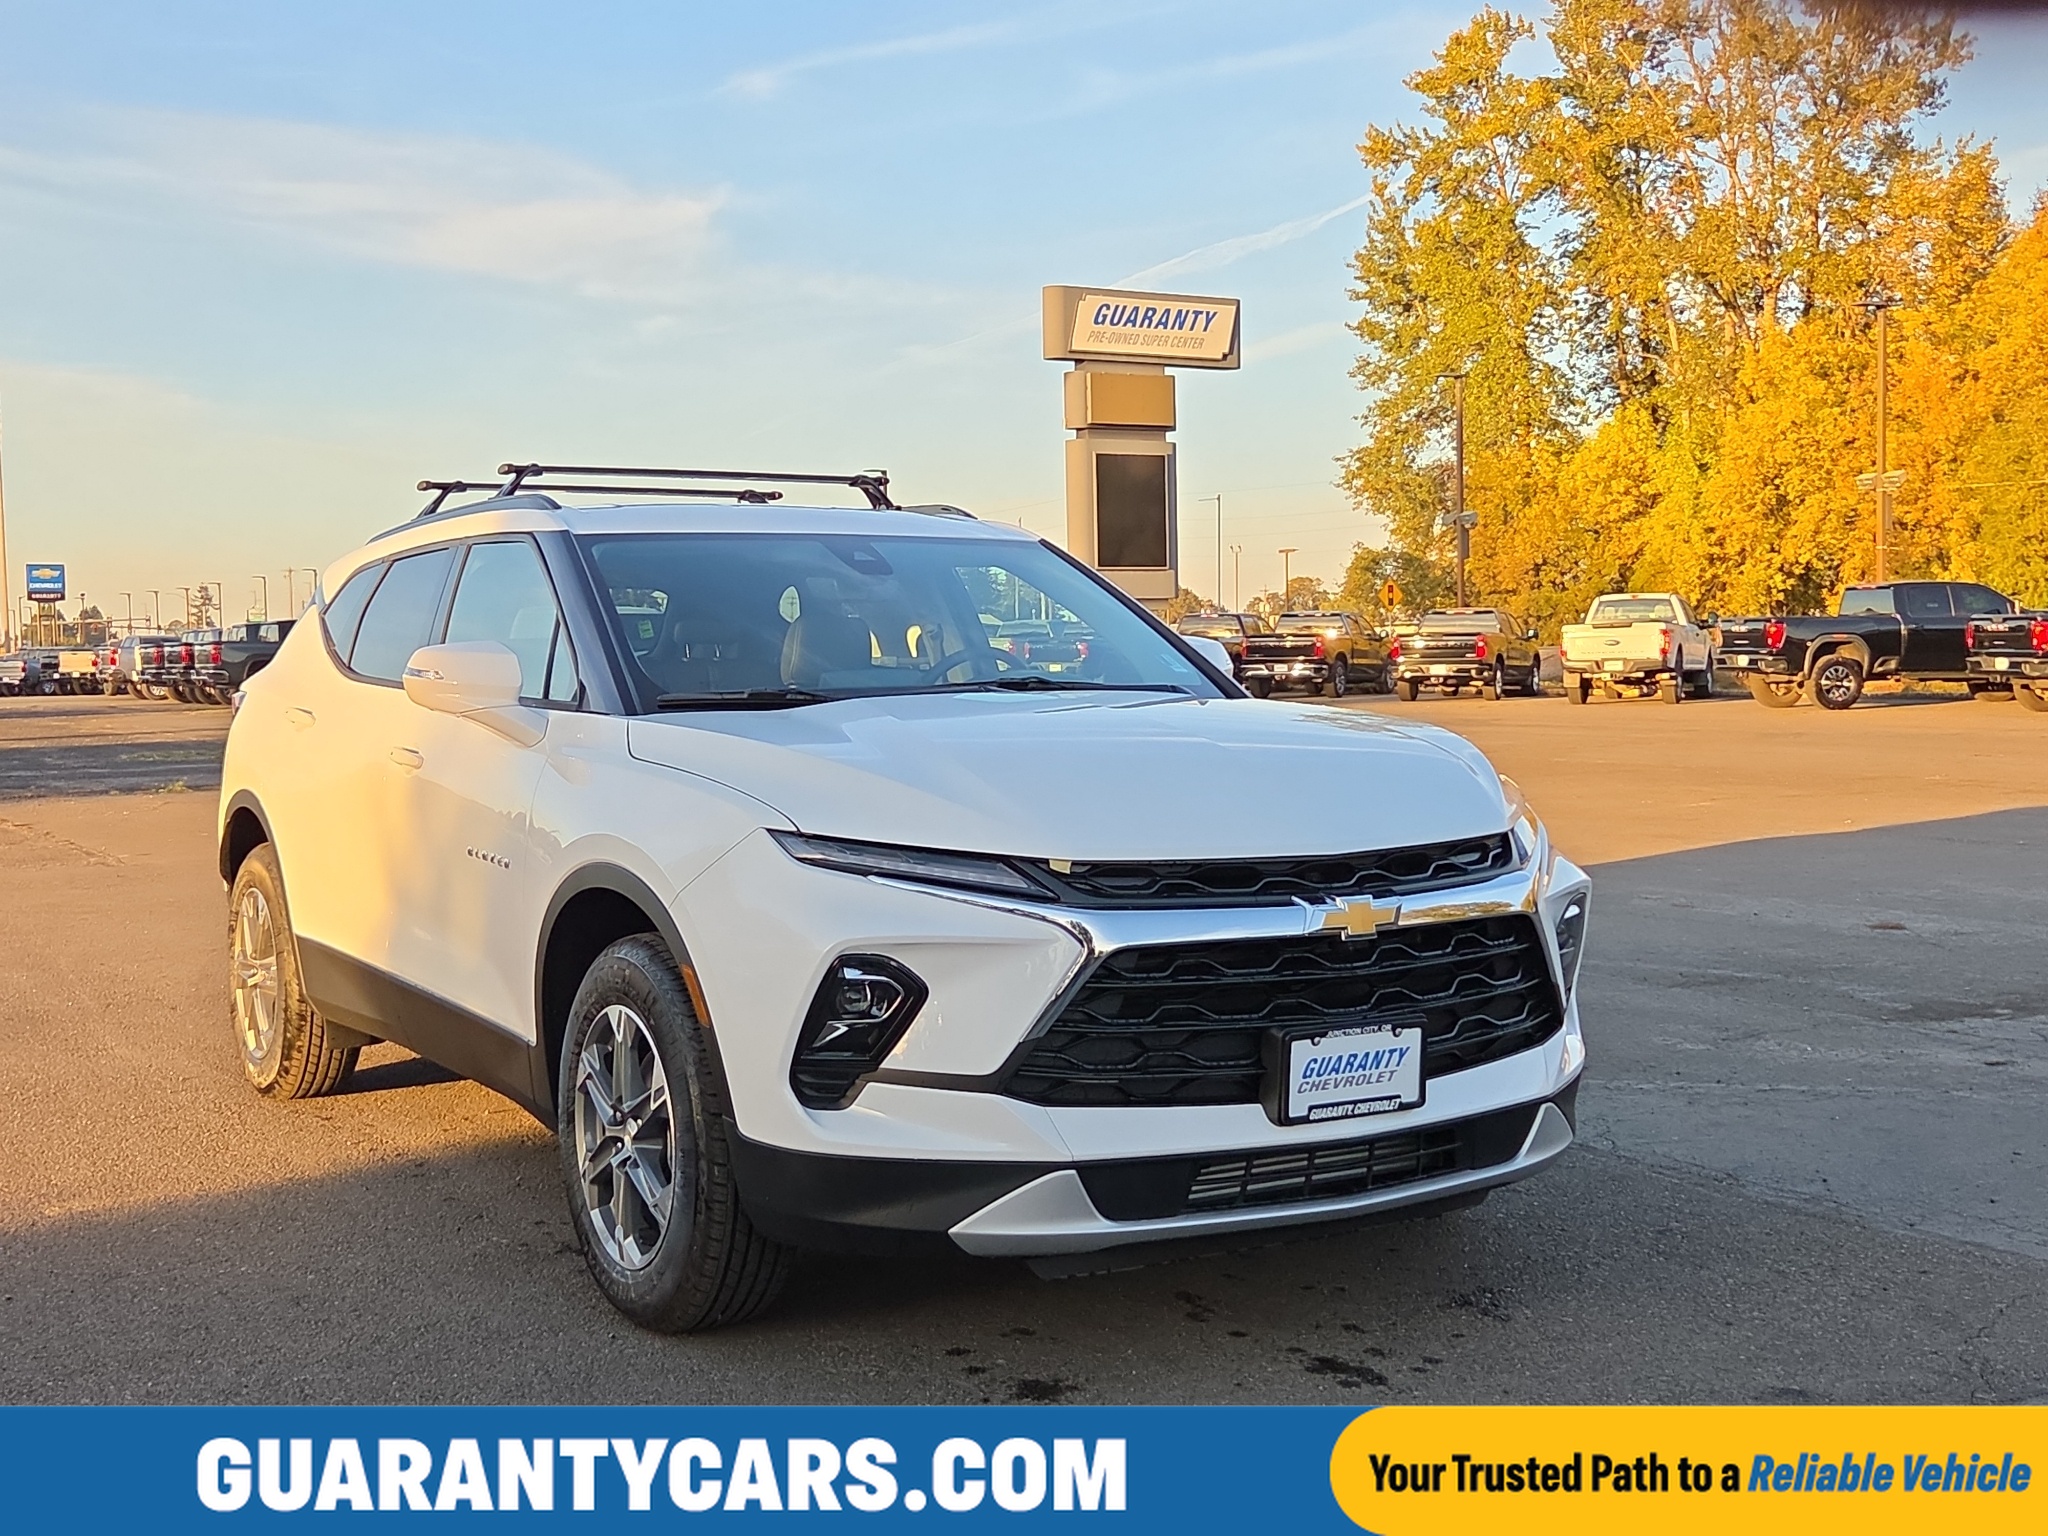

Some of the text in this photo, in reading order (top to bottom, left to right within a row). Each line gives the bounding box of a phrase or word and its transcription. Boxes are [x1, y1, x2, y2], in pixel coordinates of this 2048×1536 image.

[1093, 303, 1218, 332] GUARANTY
[1087, 331, 1206, 350] PRE-OWNED SUPER CENTER
[1302, 1047, 1411, 1079] GUARANTY
[1297, 1070, 1398, 1094] CHEVROLET
[1354, 1099, 1401, 1114] CHEVROLET
